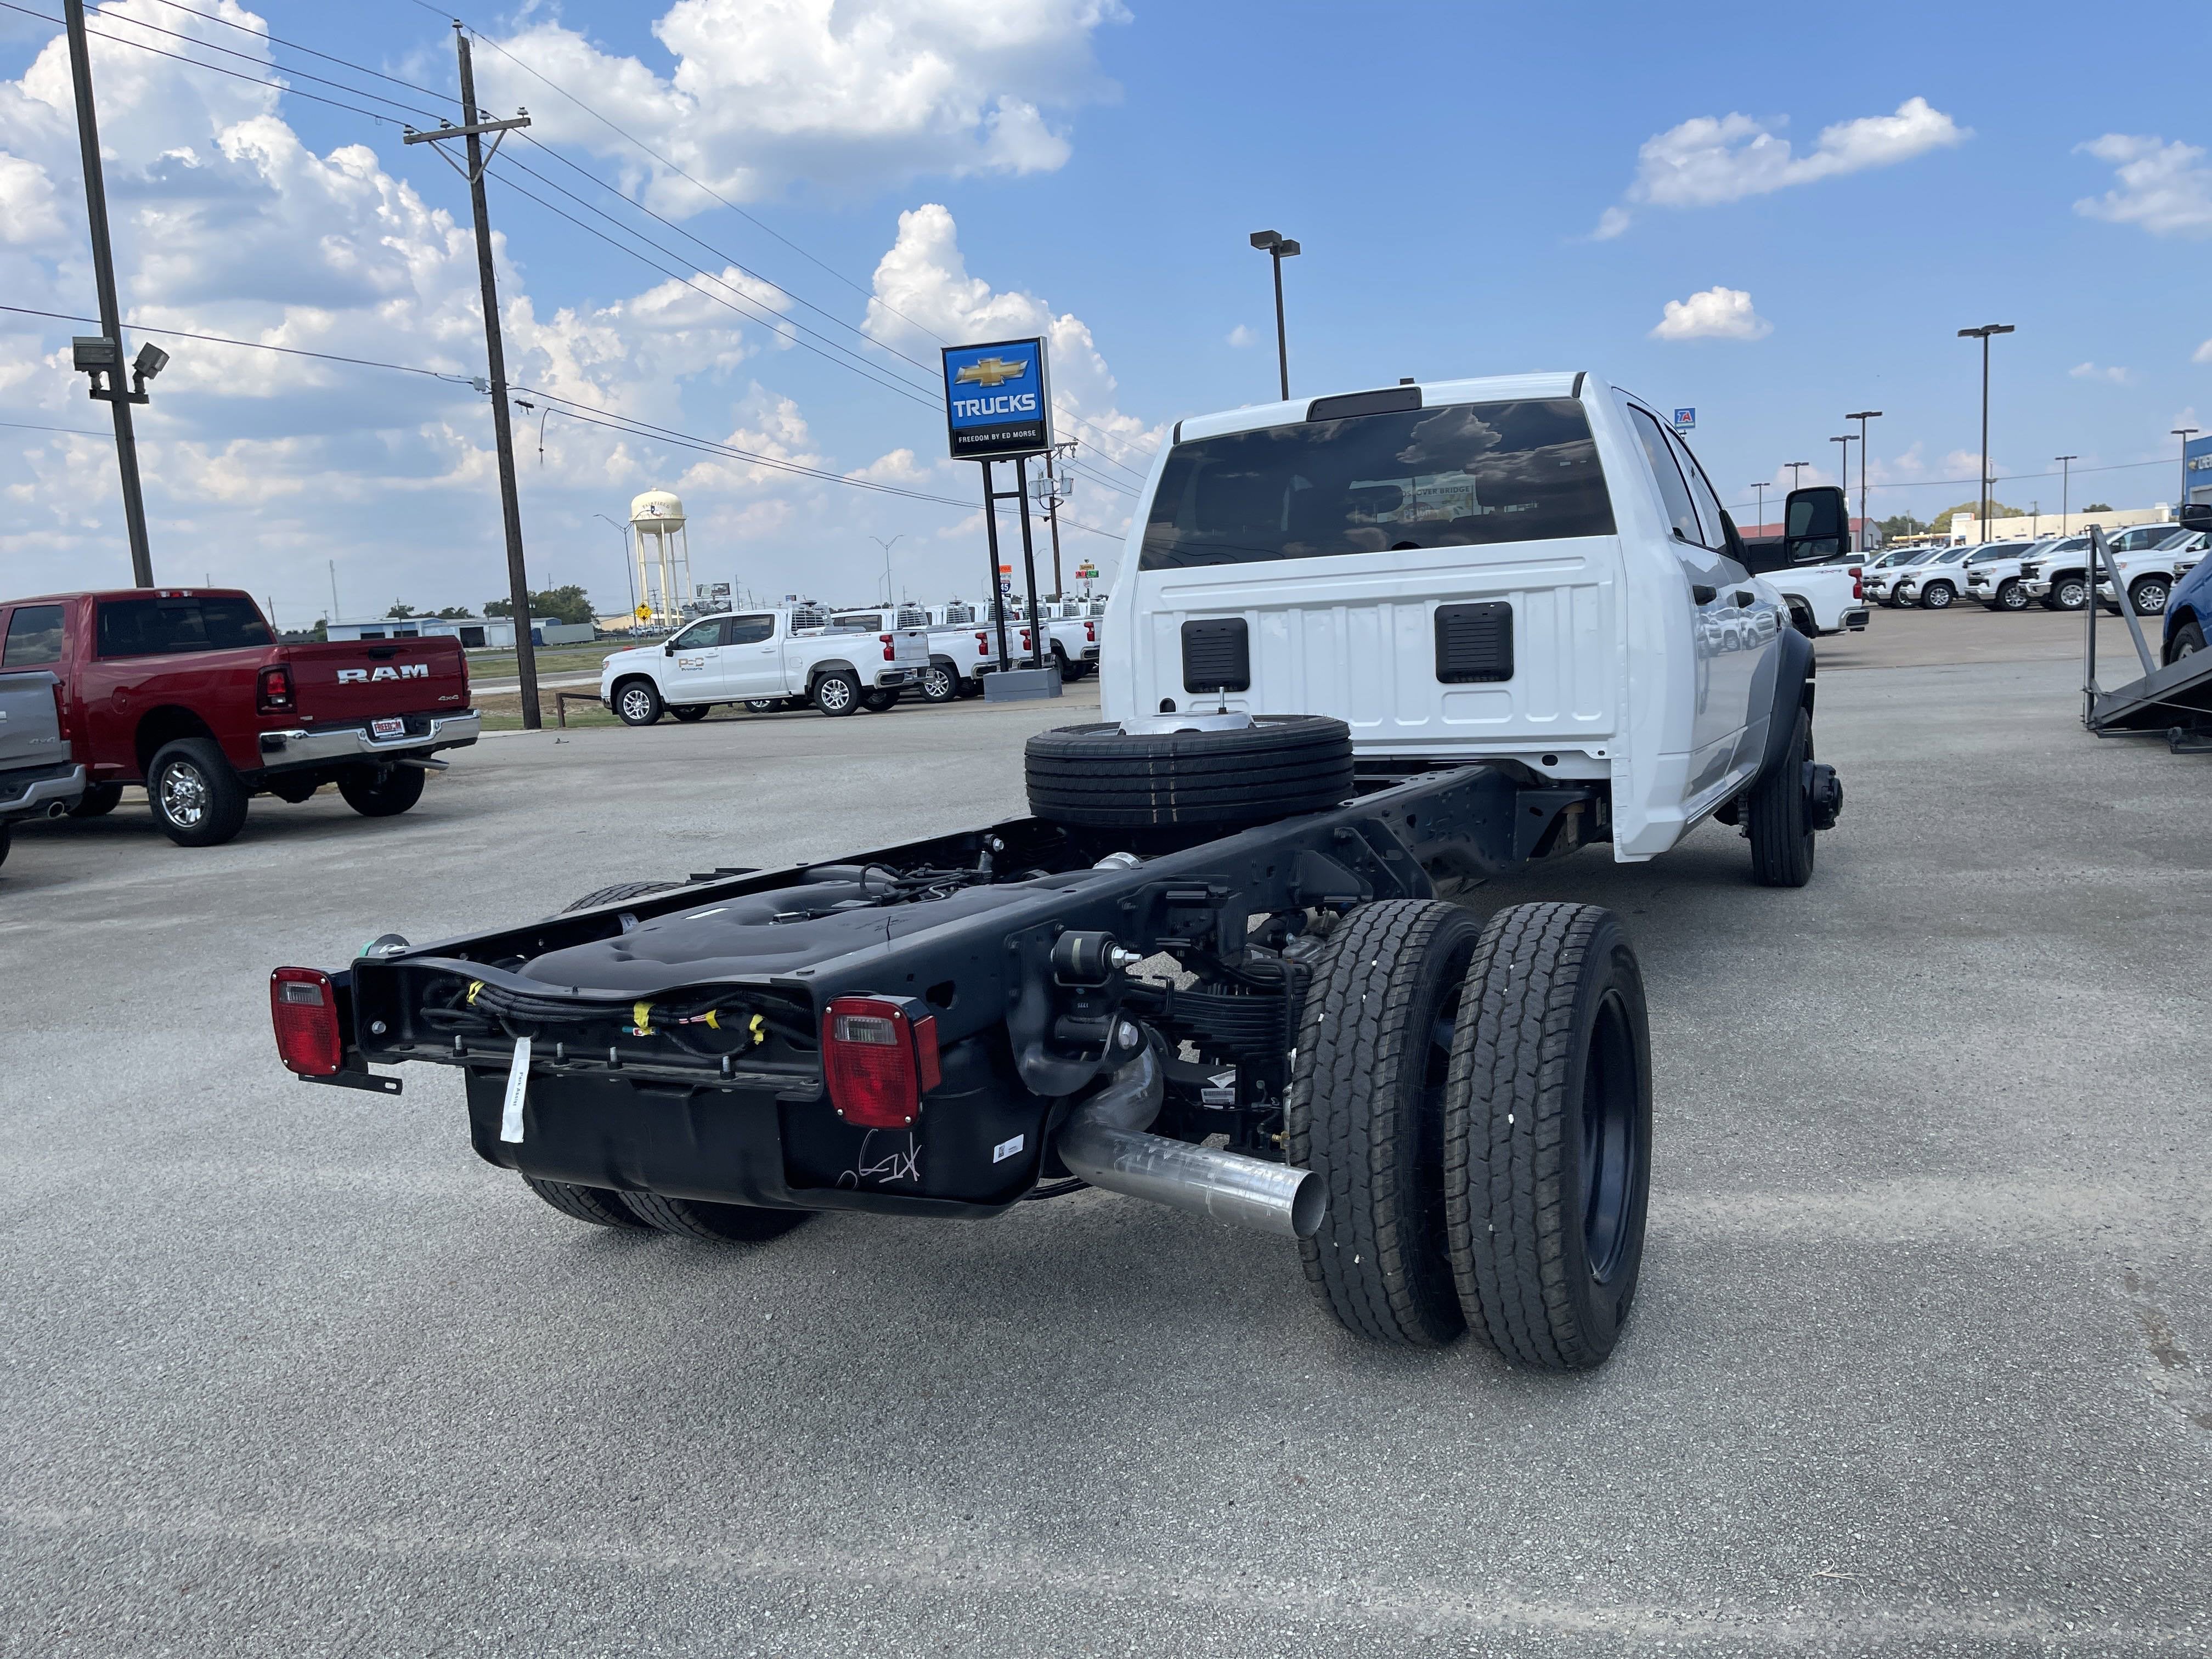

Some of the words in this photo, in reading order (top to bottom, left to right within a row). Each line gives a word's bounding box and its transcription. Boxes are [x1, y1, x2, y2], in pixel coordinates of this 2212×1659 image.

[953, 393, 1036, 417] TRUCKS
[1677, 410, 1693, 422] TA
[958, 433, 989, 443] FREEDOM
[1013, 430, 1036, 438] MORSE
[1440, 486, 1470, 494] BRIDGE
[642, 501, 670, 510] FAIRFIELD
[336, 664, 429, 685] RAM
[512, 1088, 521, 1106] Assist
